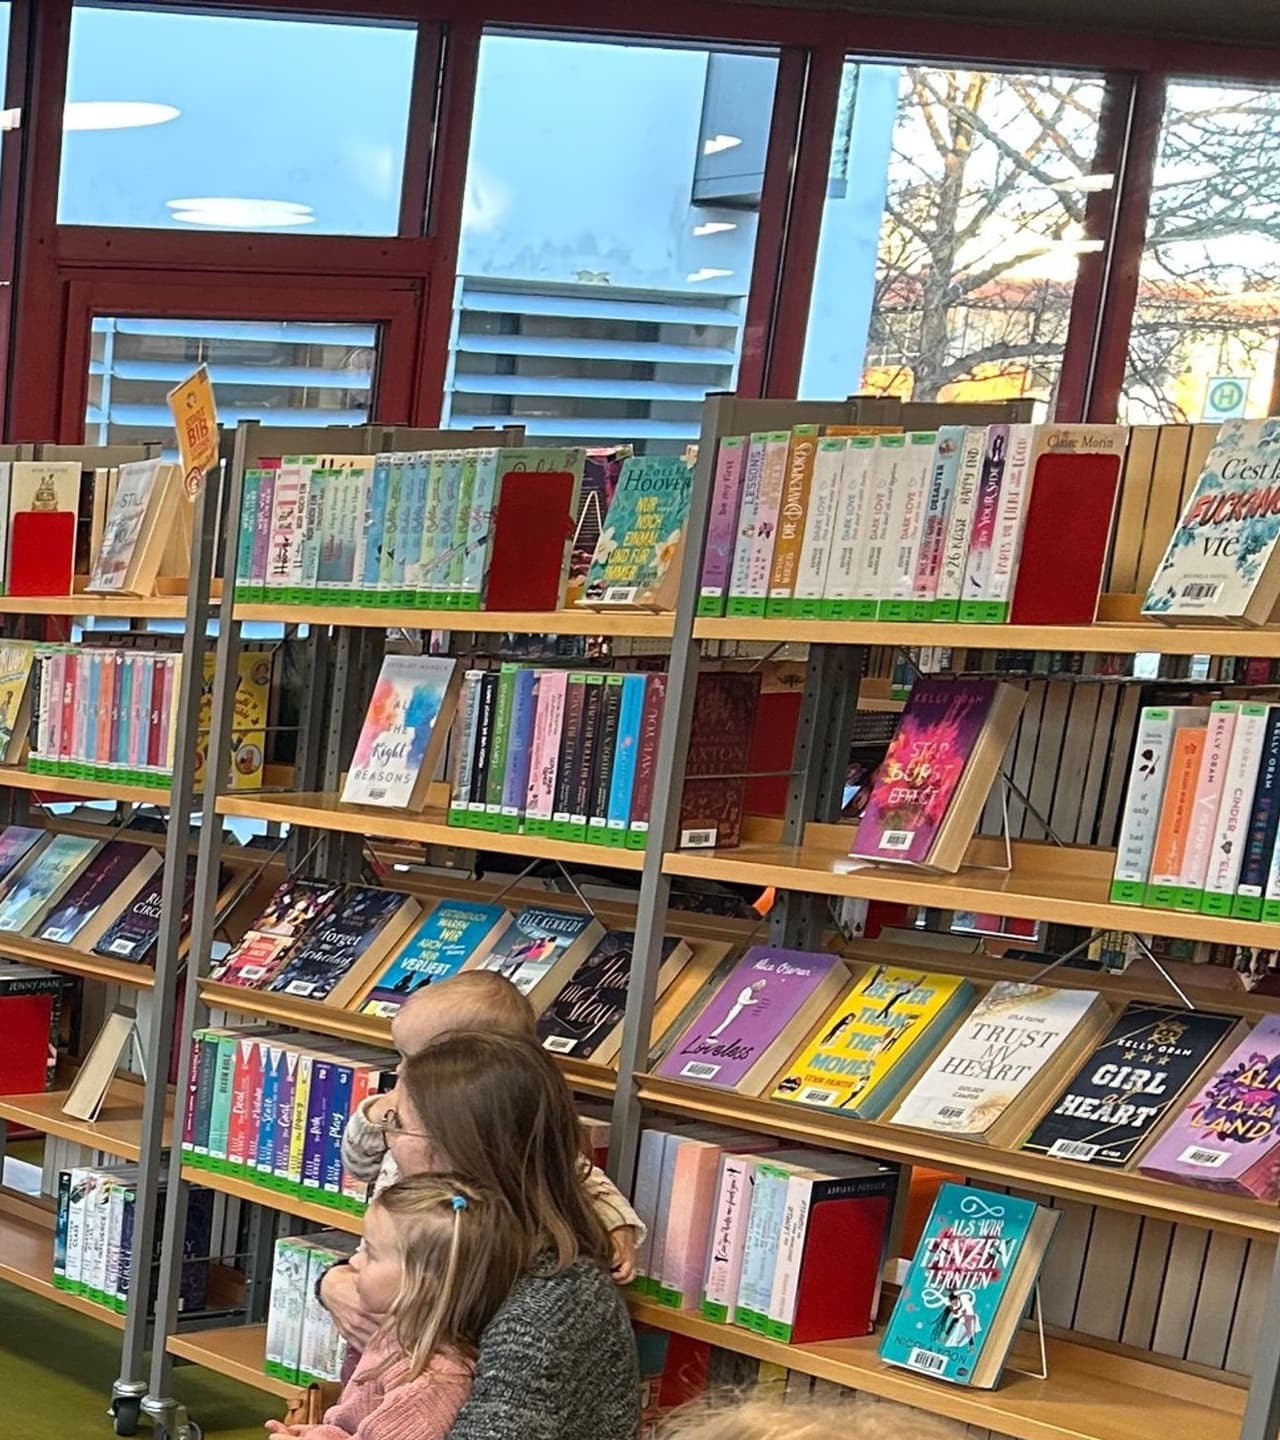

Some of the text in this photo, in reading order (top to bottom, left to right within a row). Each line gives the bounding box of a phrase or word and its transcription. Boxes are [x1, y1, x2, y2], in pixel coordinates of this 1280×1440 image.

[187, 418, 209, 448] BIB
[1081, 435, 1114, 449] Morin
[1221, 458, 1270, 481] C'est
[1202, 529, 1241, 557] vie
[640, 708, 659, 779] SAVE YOU
[1208, 717, 1227, 784] KELLY ORAM
[353, 769, 412, 785] REASONS
[1265, 757, 1277, 789] ORAM
[1227, 788, 1244, 833] CINDER
[322, 927, 363, 947] forget
[541, 915, 585, 933] KENNEDY
[594, 957, 632, 990] Tak
[680, 1034, 754, 1060] Loveless
[846, 1032, 882, 1051] THE
[968, 1022, 1060, 1049] TRUST
[1116, 1038, 1193, 1058] KELLY ORAM
[807, 1052, 877, 1076] MOVIES
[938, 1056, 1032, 1082] HEART
[1090, 1062, 1170, 1096] GIRL
[232, 1090, 246, 1114] Deal
[1054, 1093, 1158, 1128] HEART
[328, 1112, 344, 1139] Play
[1190, 1111, 1272, 1139] LAND
[948, 1218, 1005, 1237] ALS WIR
[920, 1237, 1018, 1269] TANZEN
[924, 1268, 993, 1290] LERNTEN
